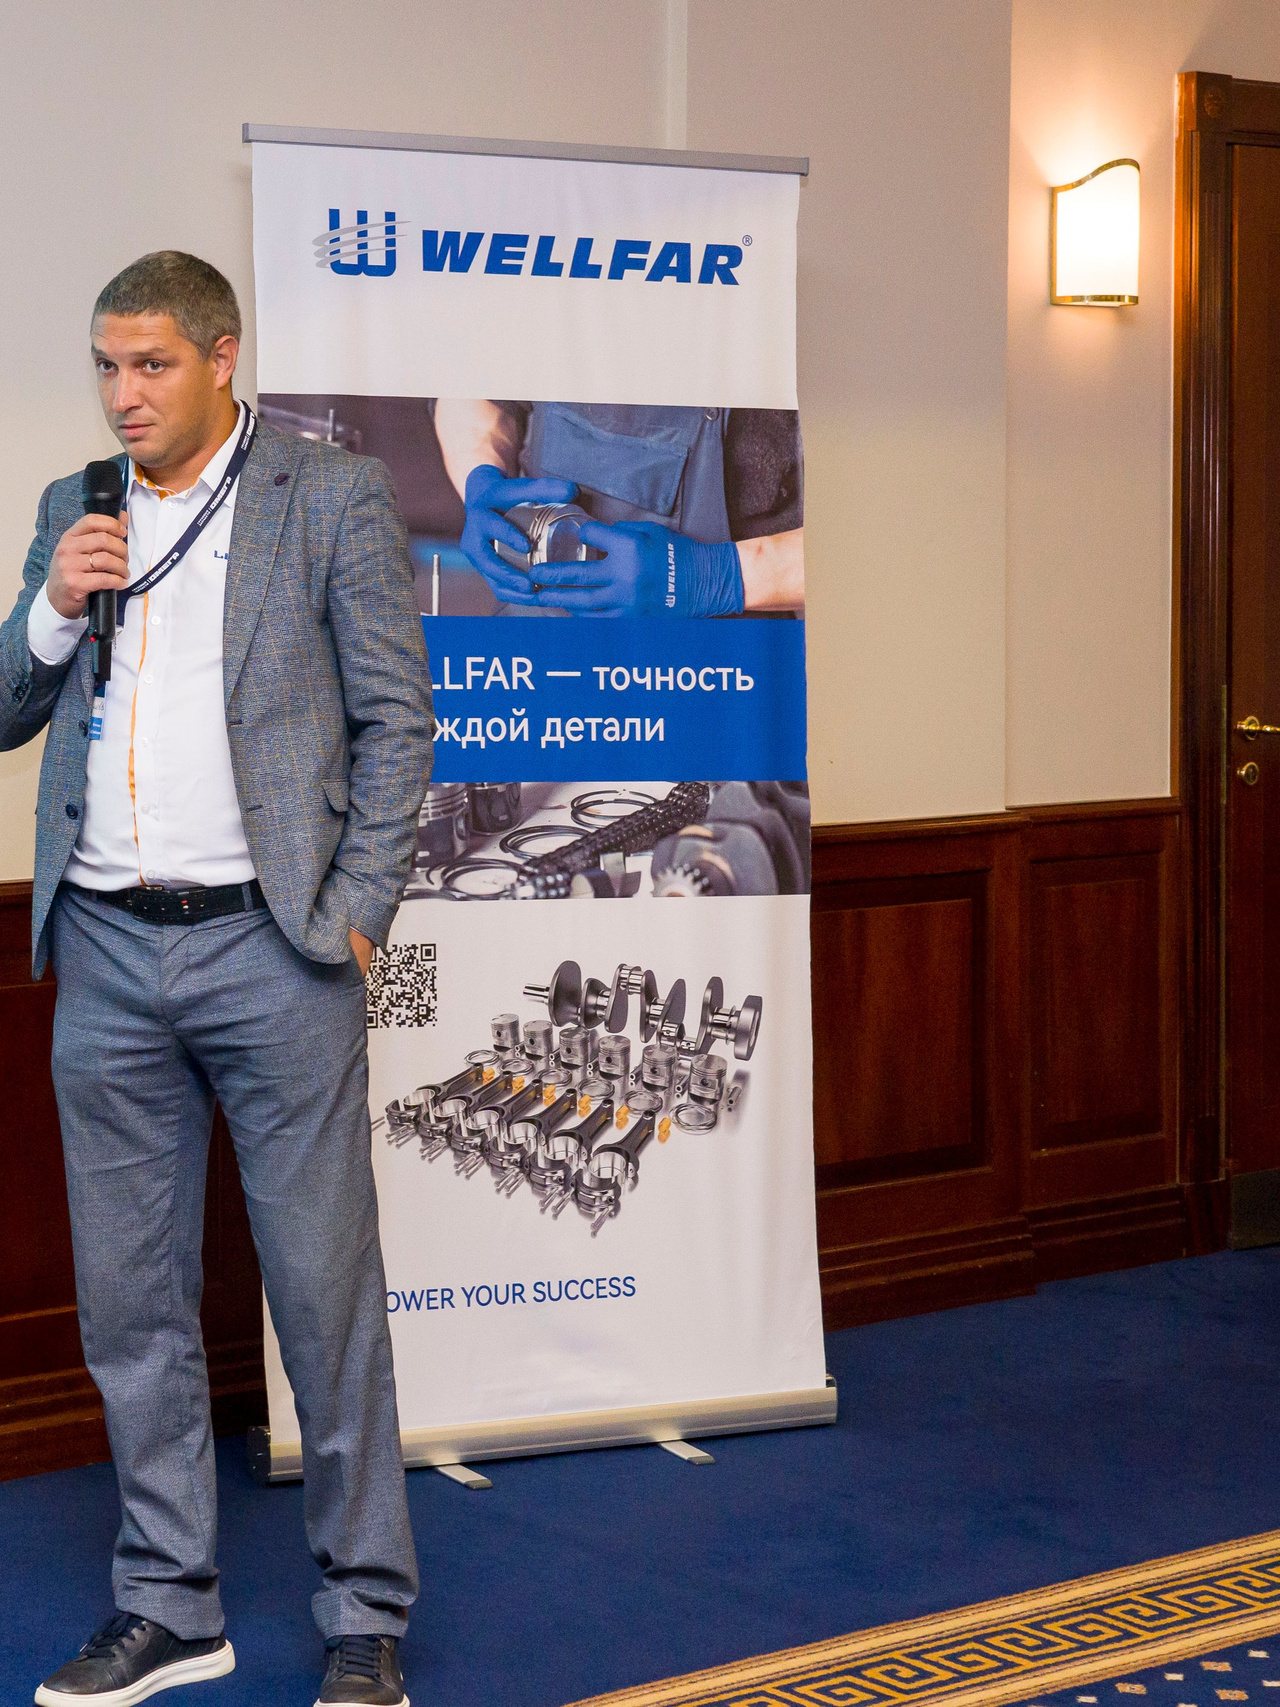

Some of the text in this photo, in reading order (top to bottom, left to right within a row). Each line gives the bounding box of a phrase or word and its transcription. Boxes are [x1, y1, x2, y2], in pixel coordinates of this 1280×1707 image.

[666, 542, 675, 594] WELLFAR
[431, 656, 535, 691] LFAR
[592, 666, 755, 691] точность
[540, 714, 665, 749] детали
[461, 1282, 526, 1308] YOUR
[532, 1276, 637, 1303] SUCCESS
